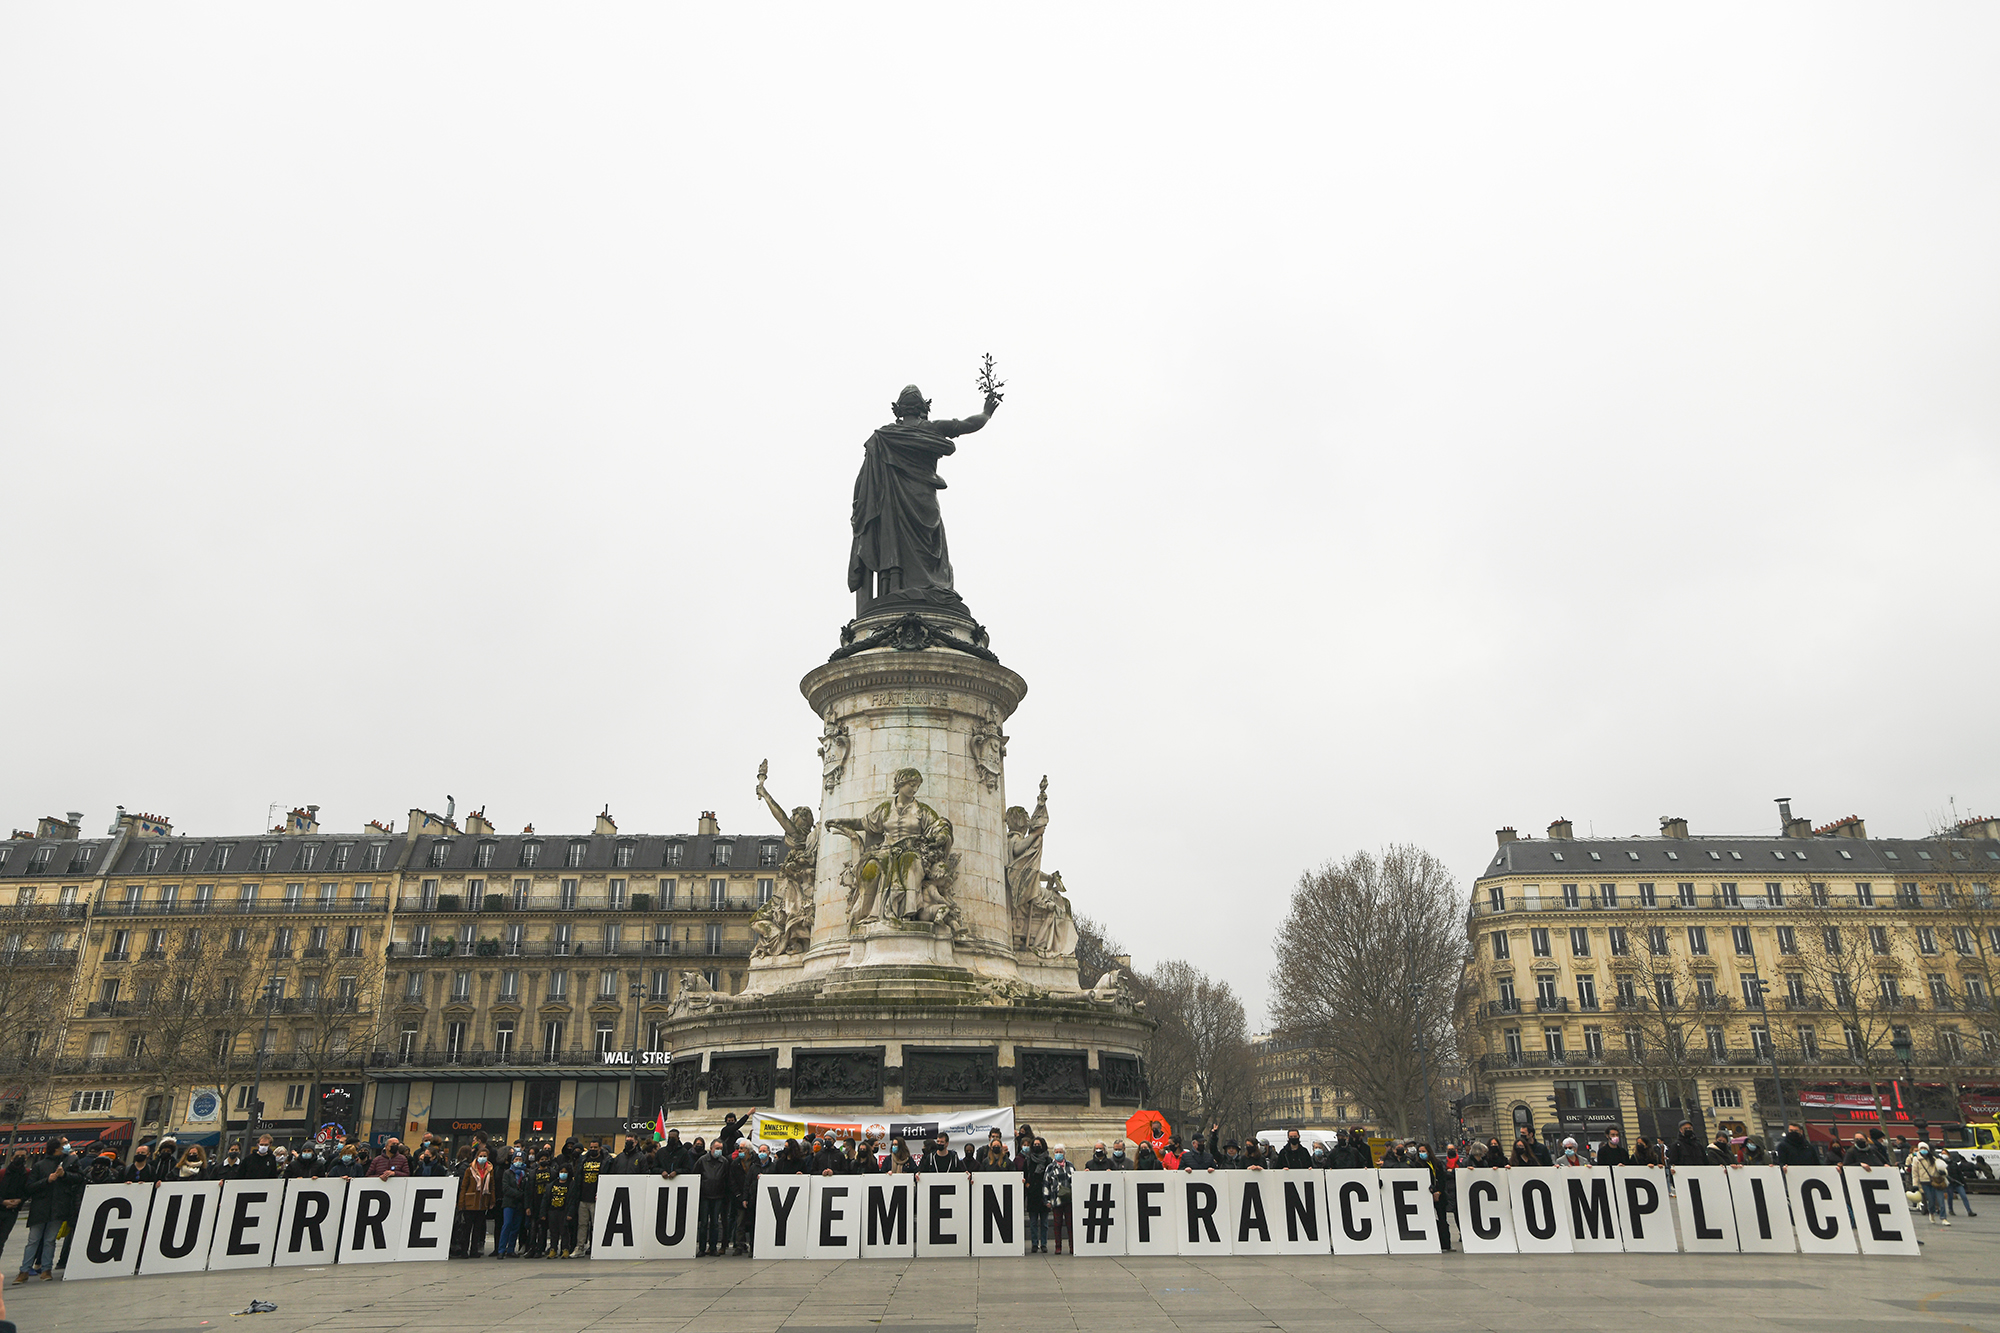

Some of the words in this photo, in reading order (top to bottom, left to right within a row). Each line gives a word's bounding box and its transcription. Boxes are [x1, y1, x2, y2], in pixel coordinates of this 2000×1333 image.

[642, 1051, 674, 1064] STRE
[452, 1121, 482, 1131] Orange
[902, 1126, 927, 1137] fidh
[830, 1127, 855, 1138] CAT
[86, 1189, 444, 1263] GUERRE
[601, 1187, 689, 1247] AU
[767, 1185, 1013, 1247] YEMEN
[1082, 1181, 1427, 1244] #FRANCE
[1469, 1179, 1903, 1242] COMPLICE
